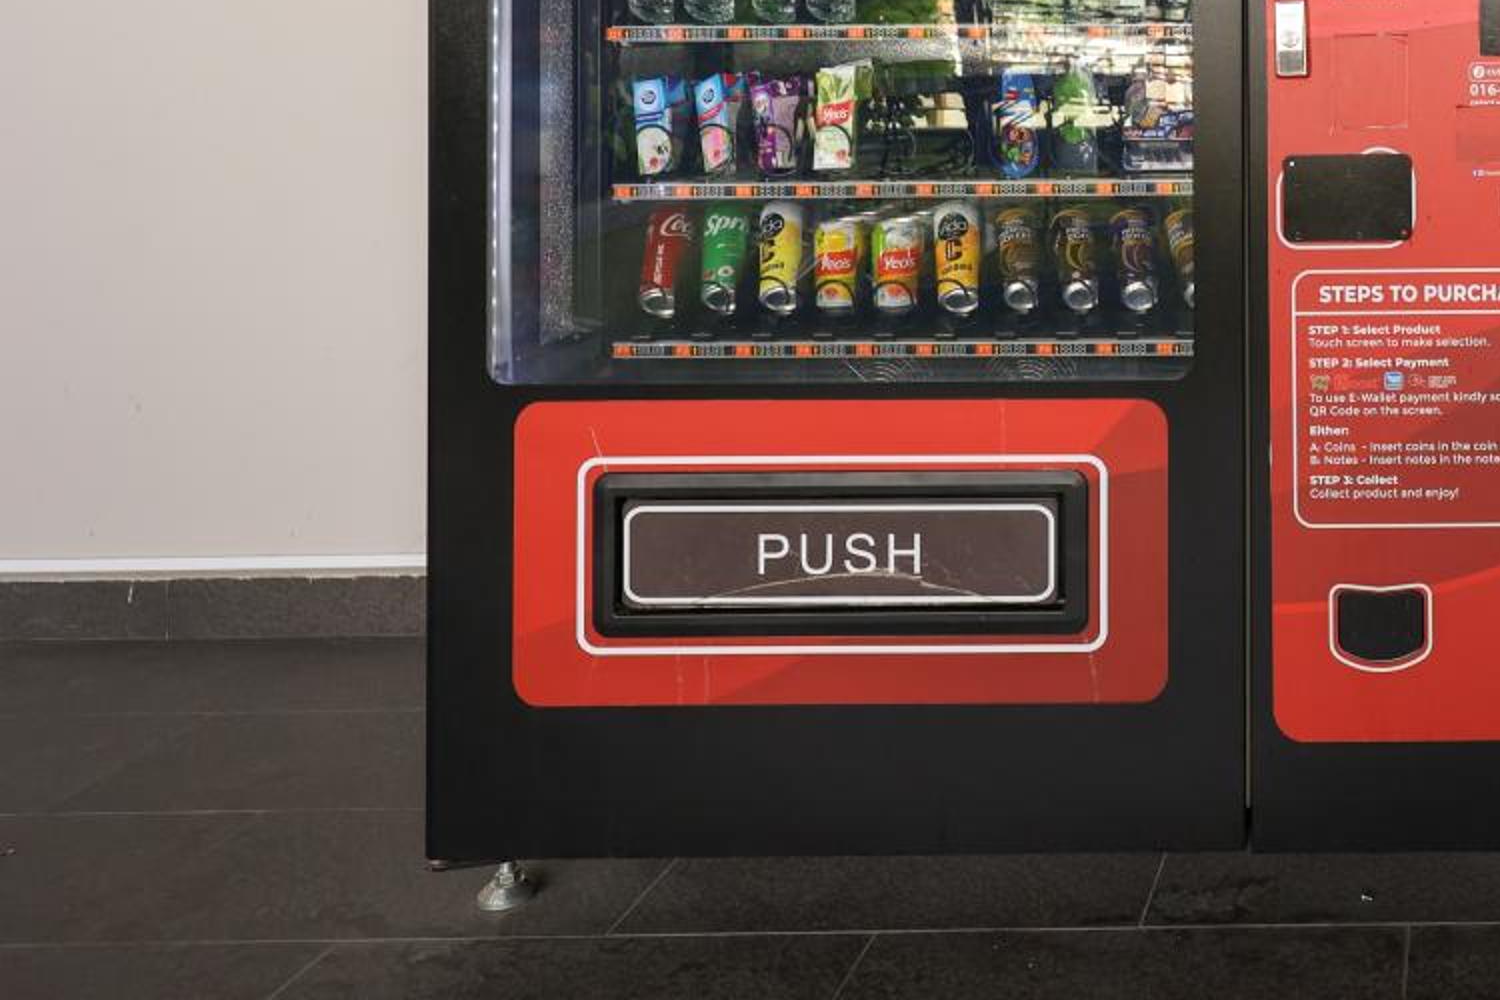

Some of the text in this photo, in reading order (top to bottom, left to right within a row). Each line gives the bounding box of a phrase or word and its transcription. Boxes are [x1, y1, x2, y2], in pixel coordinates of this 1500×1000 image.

[1319, 285, 1385, 303] STEPS
[1389, 285, 1418, 302] TO
[1308, 325, 1339, 335] STEP
[1353, 325, 1390, 335] Select
[1393, 325, 1441, 335] Product
[1309, 338, 1342, 348] Touch
[1345, 339, 1384, 347] screen
[1387, 338, 1398, 347] to
[1401, 337, 1433, 347] make
[1309, 359, 1339, 368] STEP
[1355, 358, 1392, 368] Select
[1395, 358, 1449, 370] Payment
[1310, 393, 1322, 402] To
[1325, 395, 1345, 403] use
[1399, 392, 1449, 405] payment
[1453, 392, 1486, 404] kindly
[1310, 407, 1326, 417] QR
[1330, 406, 1360, 416] Code
[1363, 408, 1377, 416] on
[1381, 406, 1399, 415] the
[1323, 442, 1356, 452] Coins
[1369, 442, 1403, 452] Insert
[1405, 442, 1435, 451] coins
[1438, 441, 1449, 451] in
[1452, 441, 1471, 451] the
[1473, 440, 1498, 451] coin
[1323, 455, 1358, 465] Notes
[1369, 455, 1402, 465] Insert
[1405, 455, 1436, 465] notes
[1440, 454, 1450, 464] in
[1453, 454, 1472, 464] the
[1475, 454, 1500, 464] note
[1310, 475, 1340, 485] STEP
[1357, 475, 1399, 485] Collect
[1310, 489, 1350, 499] Collect
[1353, 488, 1398, 500] product
[1401, 488, 1423, 498] and
[757, 533, 921, 575] PUSH
